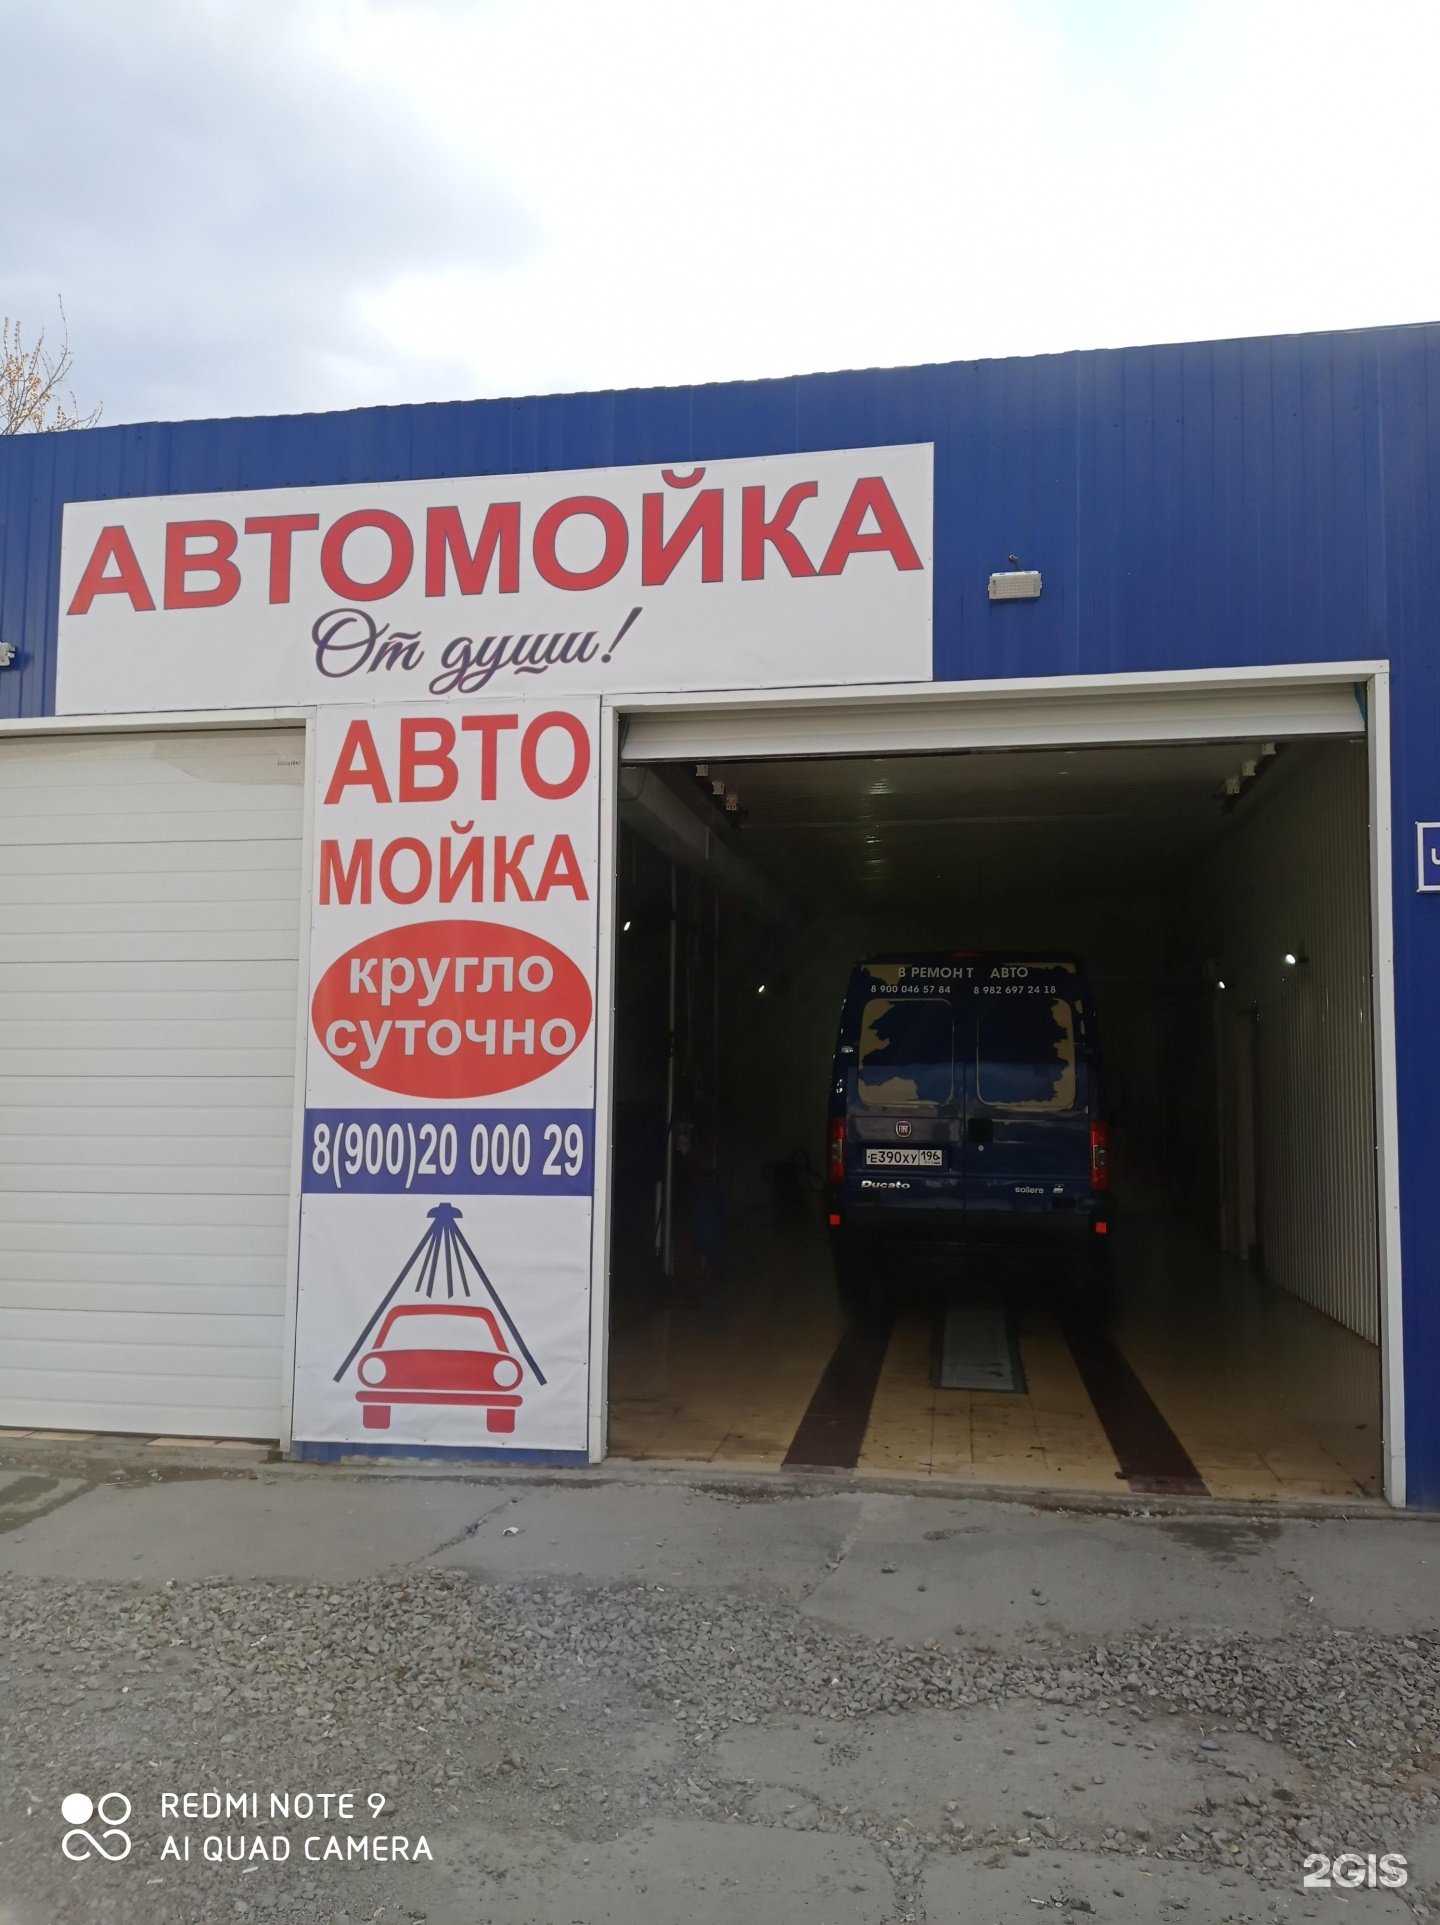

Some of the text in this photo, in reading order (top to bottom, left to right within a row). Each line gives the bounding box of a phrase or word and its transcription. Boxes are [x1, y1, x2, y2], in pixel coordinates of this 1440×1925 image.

[66, 467, 925, 616] АВТОМОЙКА
[311, 606, 643, 695] От души!
[323, 710, 591, 805] АВТО
[318, 820, 590, 906] МОЙКА
[348, 954, 555, 1008] кругло
[879, 985, 898, 993] 900
[990, 966, 1029, 979] АВТО
[325, 1017, 577, 1069] суточно
[312, 1122, 584, 1188] 8(900)20 000 29
